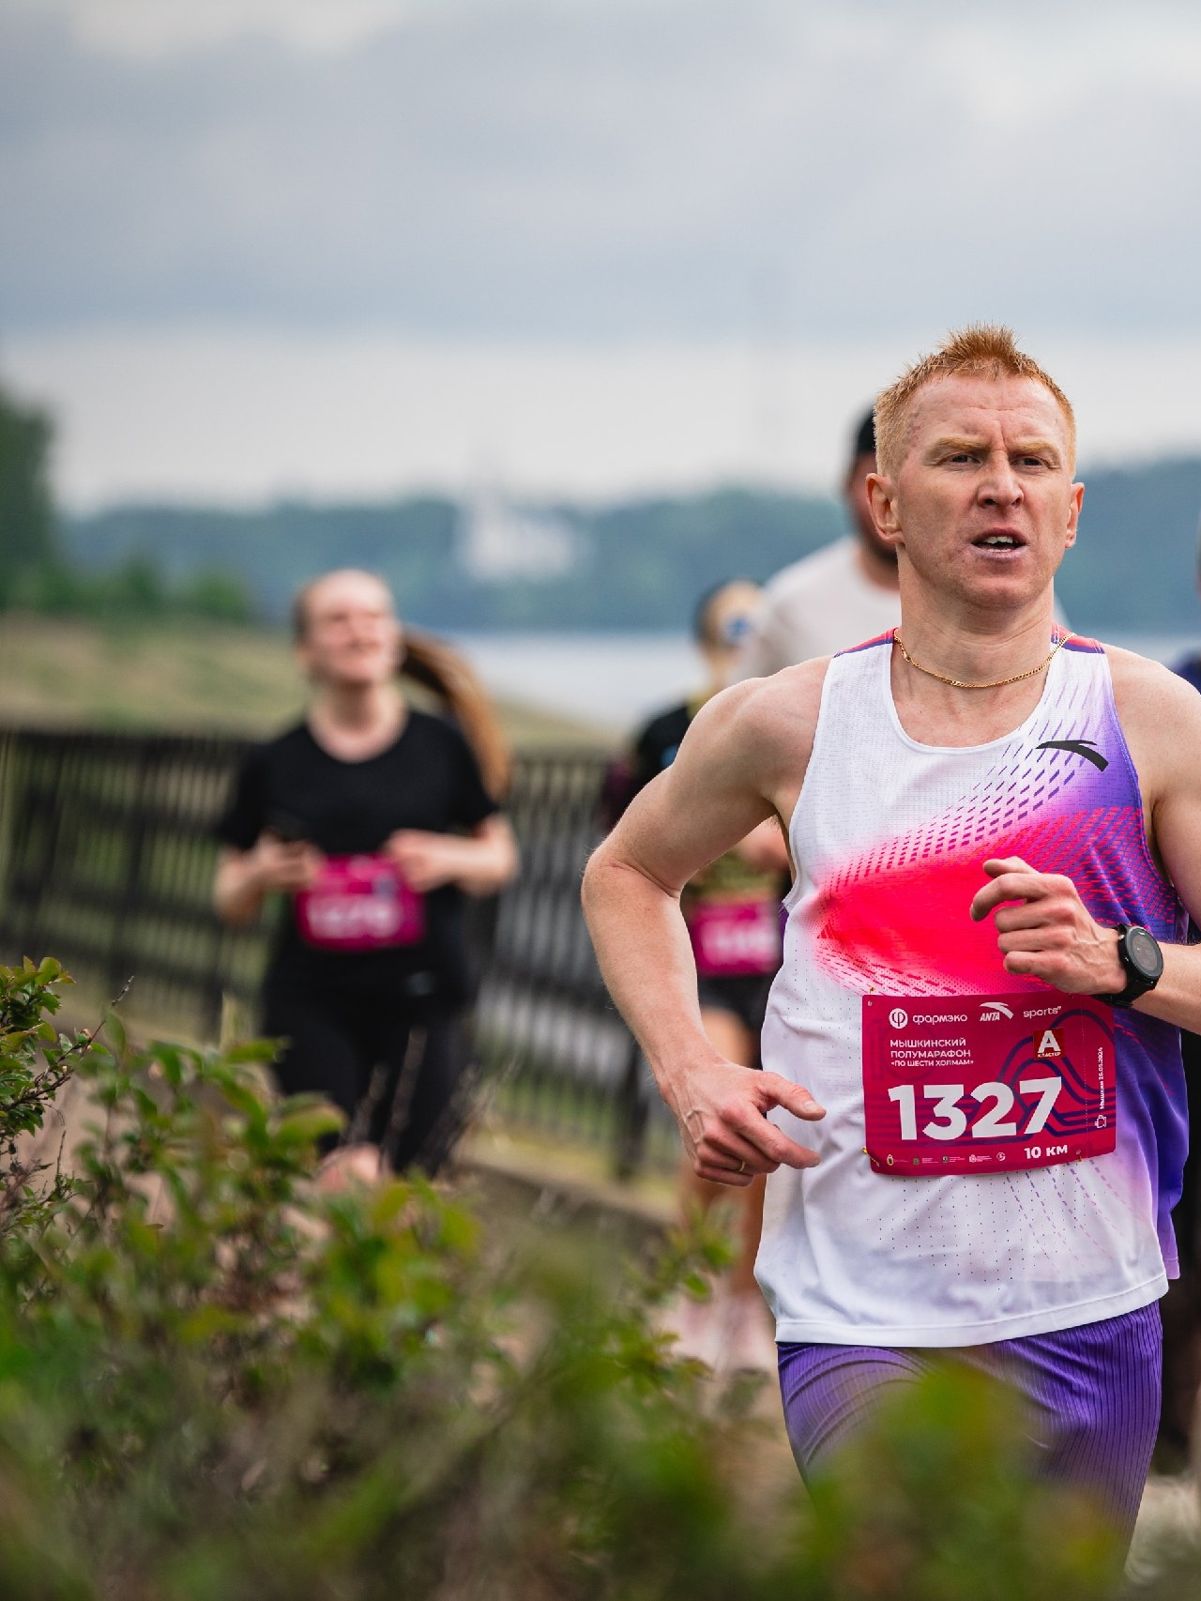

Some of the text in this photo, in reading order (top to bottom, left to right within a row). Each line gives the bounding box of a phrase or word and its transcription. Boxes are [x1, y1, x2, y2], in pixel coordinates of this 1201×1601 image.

[913, 1013, 967, 1025] фармэко
[980, 1012, 1000, 1021] ANTA
[890, 1036, 966, 1048] МЫШКИНСКИЙ
[891, 1049, 971, 1059] ПОЛУМАРАФОН
[888, 1076, 1062, 1141] 1327
[1024, 1147, 1041, 1159] 10
